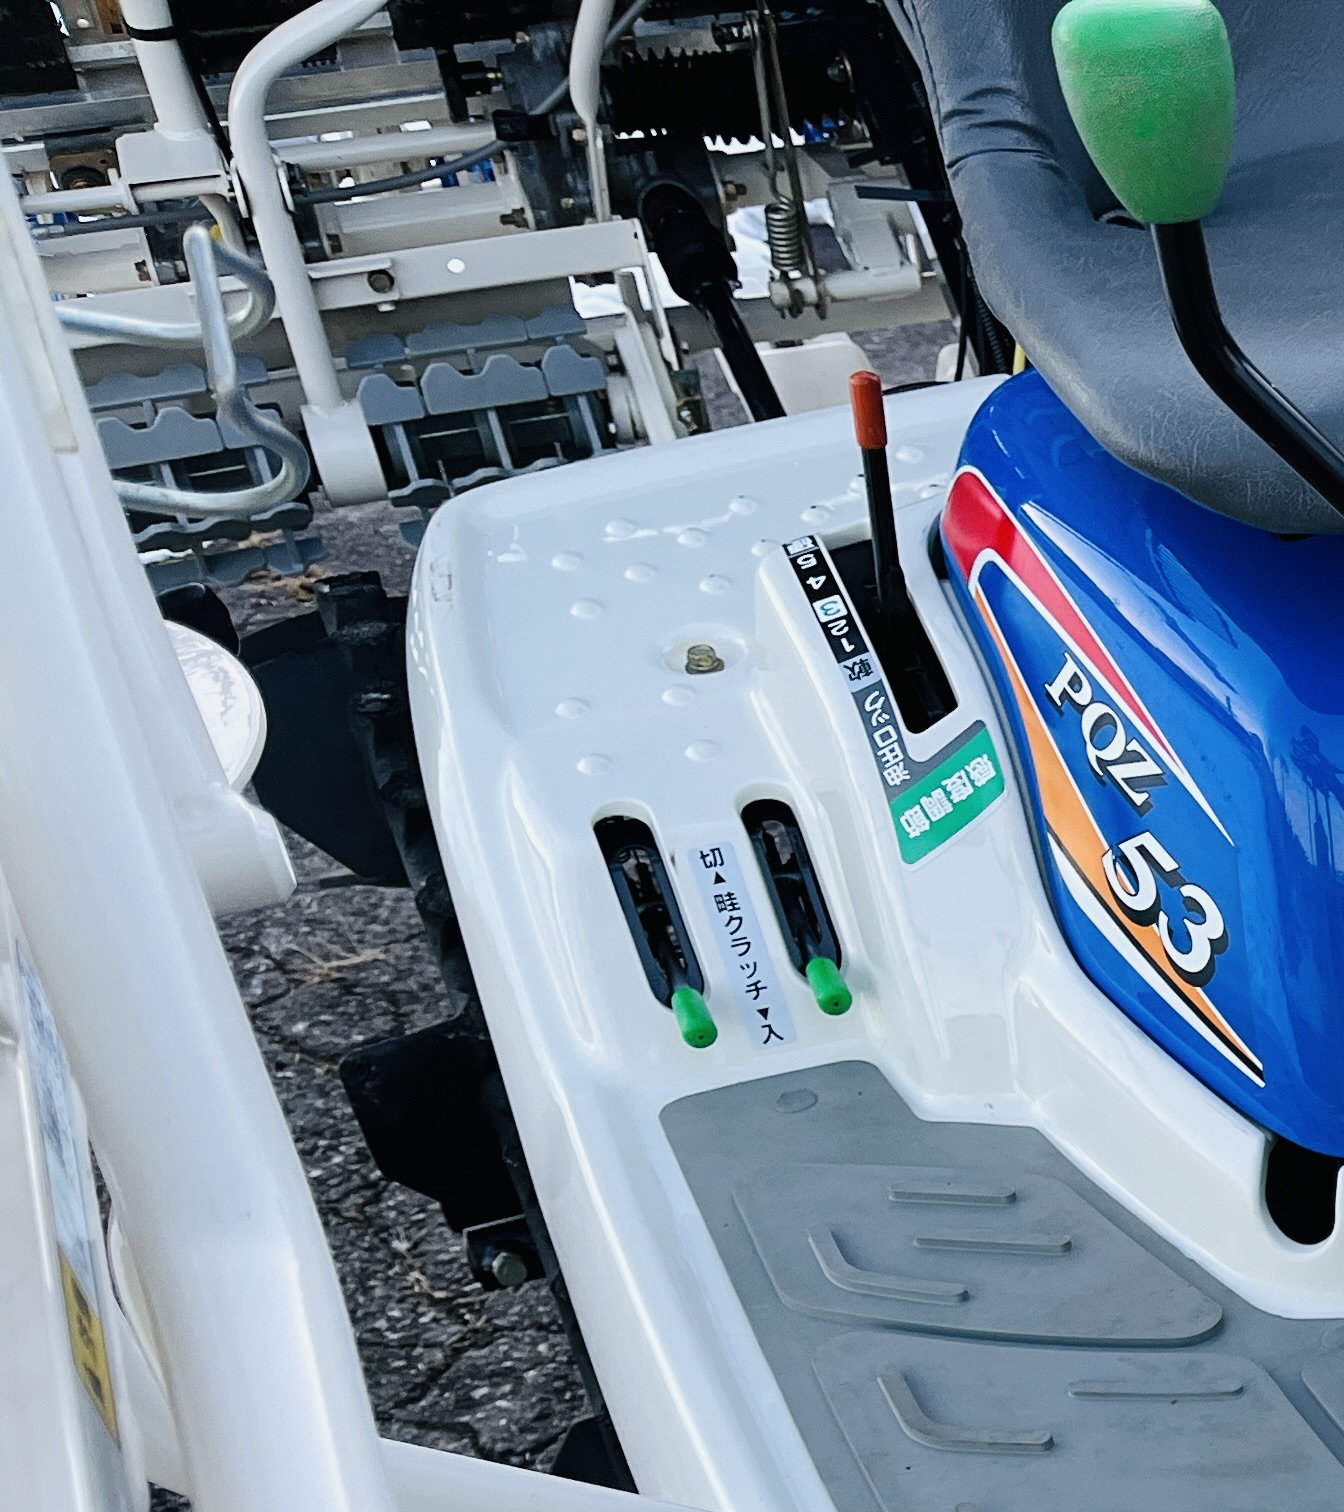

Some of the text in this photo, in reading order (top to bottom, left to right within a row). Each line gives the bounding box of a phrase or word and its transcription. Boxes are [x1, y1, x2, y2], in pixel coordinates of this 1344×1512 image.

[796, 553, 817, 570] 5
[805, 574, 827, 591] 4
[819, 600, 843, 617] 3
[827, 619, 849, 637] 2
[840, 637, 855, 653] 1
[863, 690, 911, 788] 油圧ロック
[899, 752, 998, 839] 感度調節
[1045, 652, 1228, 982] PQZ 53
[699, 847, 784, 1044] 切 畦クラッチ 入
